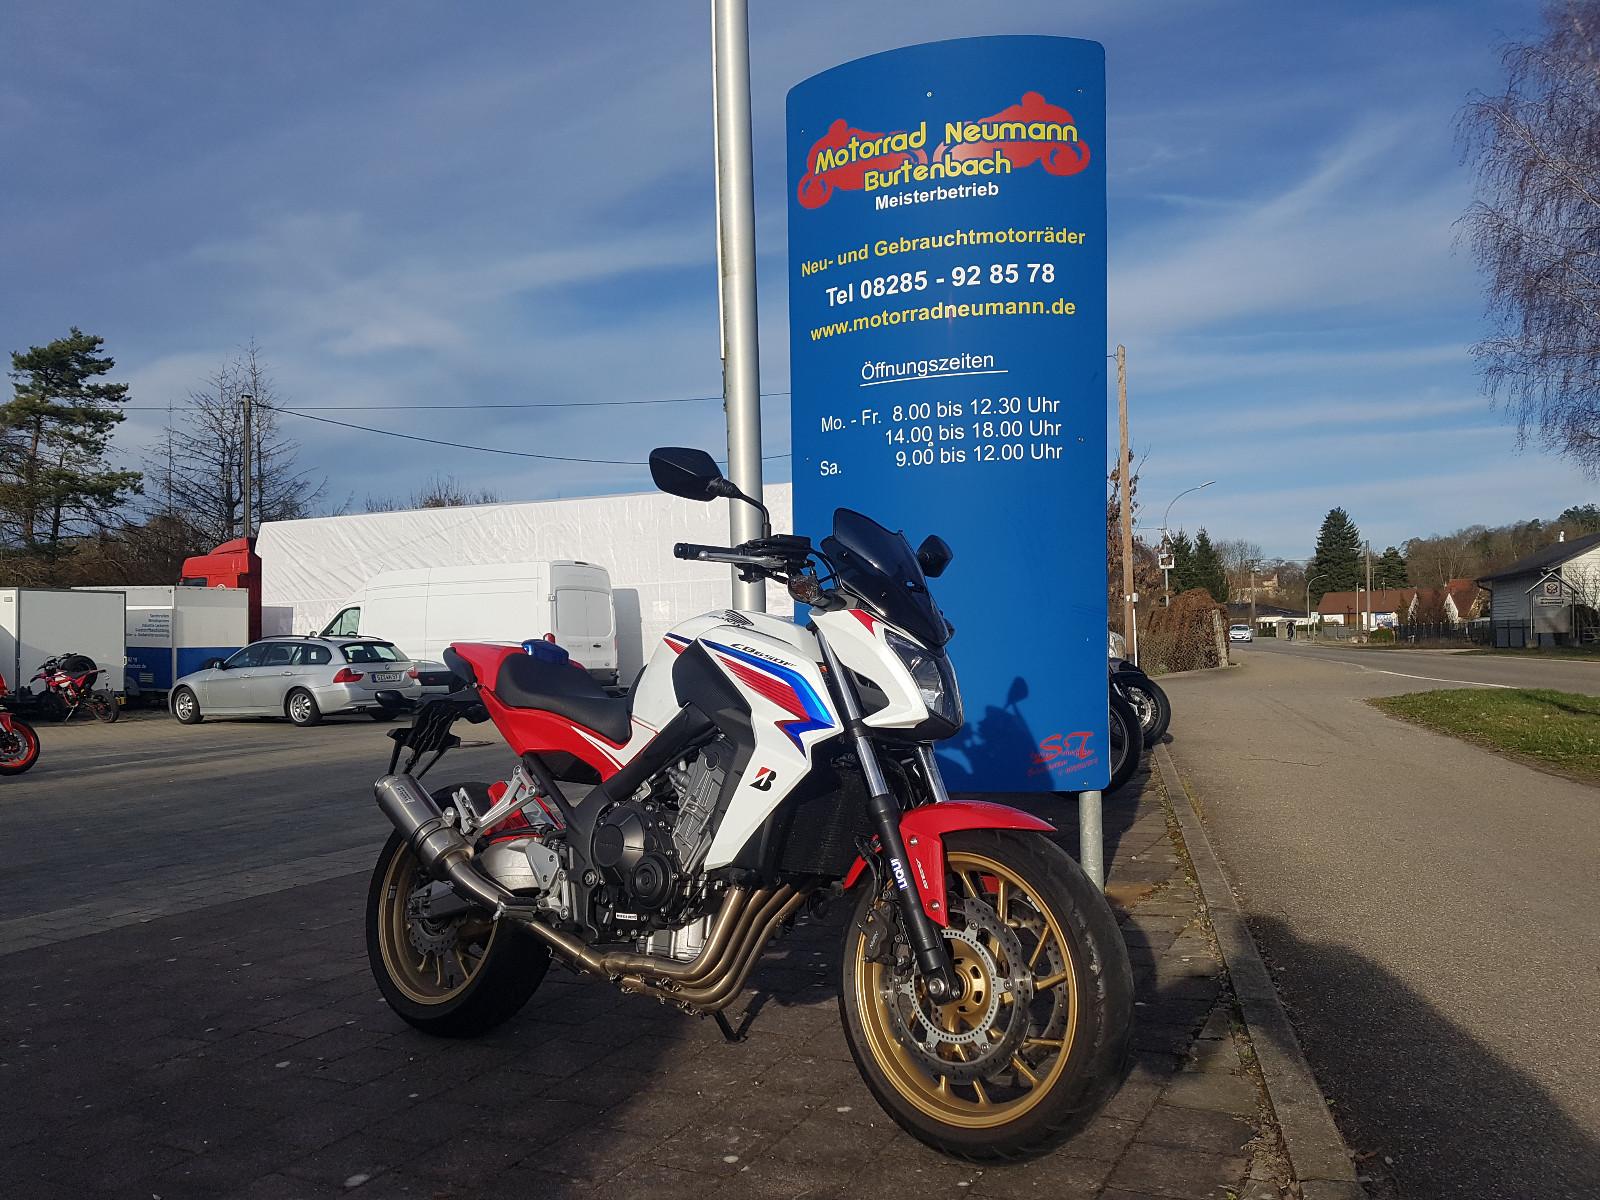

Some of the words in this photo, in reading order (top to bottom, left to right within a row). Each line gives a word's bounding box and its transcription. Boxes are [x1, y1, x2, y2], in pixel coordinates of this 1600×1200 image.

[815, 121, 927, 175] Motorrad
[945, 121, 1078, 144] Neumann
[864, 151, 1011, 191] Burtenbach
[875, 182, 999, 210] Meisterbetrieb
[801, 258, 833, 277] Neu-
[838, 244, 868, 266] und
[874, 227, 1085, 257] Gebrauchtmotorräder
[826, 283, 853, 306] Tel
[860, 270, 927, 299] 08285
[951, 265, 981, 287] 92
[990, 263, 1018, 284] 85
[1027, 263, 1055, 283] 78
[811, 297, 1076, 341] www.motorradneumann.de
[861, 353, 994, 380] Öffnungszeiten
[821, 417, 845, 432] Mo.
[862, 409, 881, 426] Fr.
[892, 403, 930, 422] 8.00
[937, 402, 963, 418] bis
[970, 398, 1021, 415] 12.30
[1028, 397, 1060, 413] Uhr
[885, 426, 932, 445] 14.00
[939, 424, 965, 441] bis
[972, 421, 1022, 438] 18.00
[1029, 420, 1062, 436] Uhr
[820, 460, 842, 476] Sa.
[896, 448, 934, 467] 9.00
[940, 448, 966, 464] bis
[973, 444, 1024, 460] 12.00
[1031, 444, 1062, 459] Uhr
